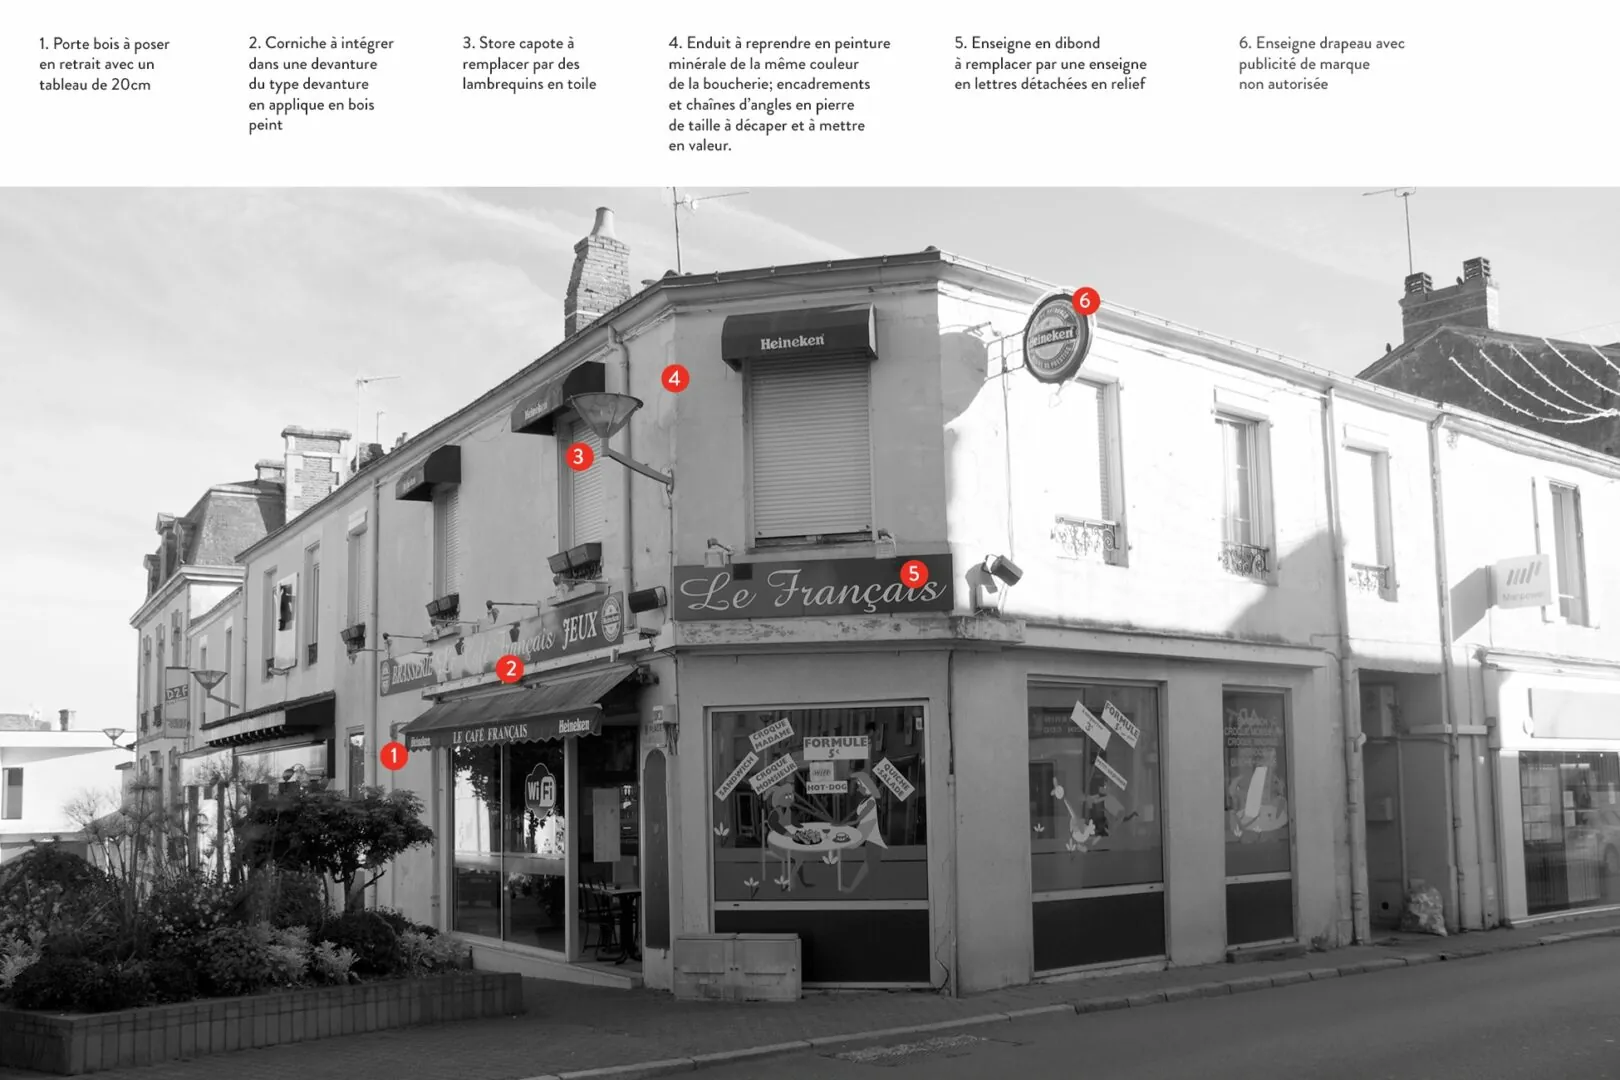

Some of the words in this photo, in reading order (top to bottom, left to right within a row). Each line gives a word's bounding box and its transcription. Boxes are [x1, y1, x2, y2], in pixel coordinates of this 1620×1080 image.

[760, 333, 825, 350] Heineken
[679, 571, 757, 611] Le
[767, 569, 948, 613] Français
[562, 610, 599, 651] JEUX
[391, 656, 433, 684] BRASSERIE
[453, 731, 463, 744] LE
[465, 726, 485, 742] CAFÉ
[487, 723, 528, 743] FRANÇAIS
[558, 717, 590, 734] Heineken
[753, 719, 788, 741] CROQUE
[754, 728, 792, 751] MADAME
[804, 737, 868, 748] FORMULE
[718, 756, 755, 797] SANDWICH
[755, 757, 788, 782] CROQUE
[755, 763, 797, 794] MONSIEUR
[884, 763, 911, 791] QUICHE
[807, 783, 847, 792] HOT-DOG
